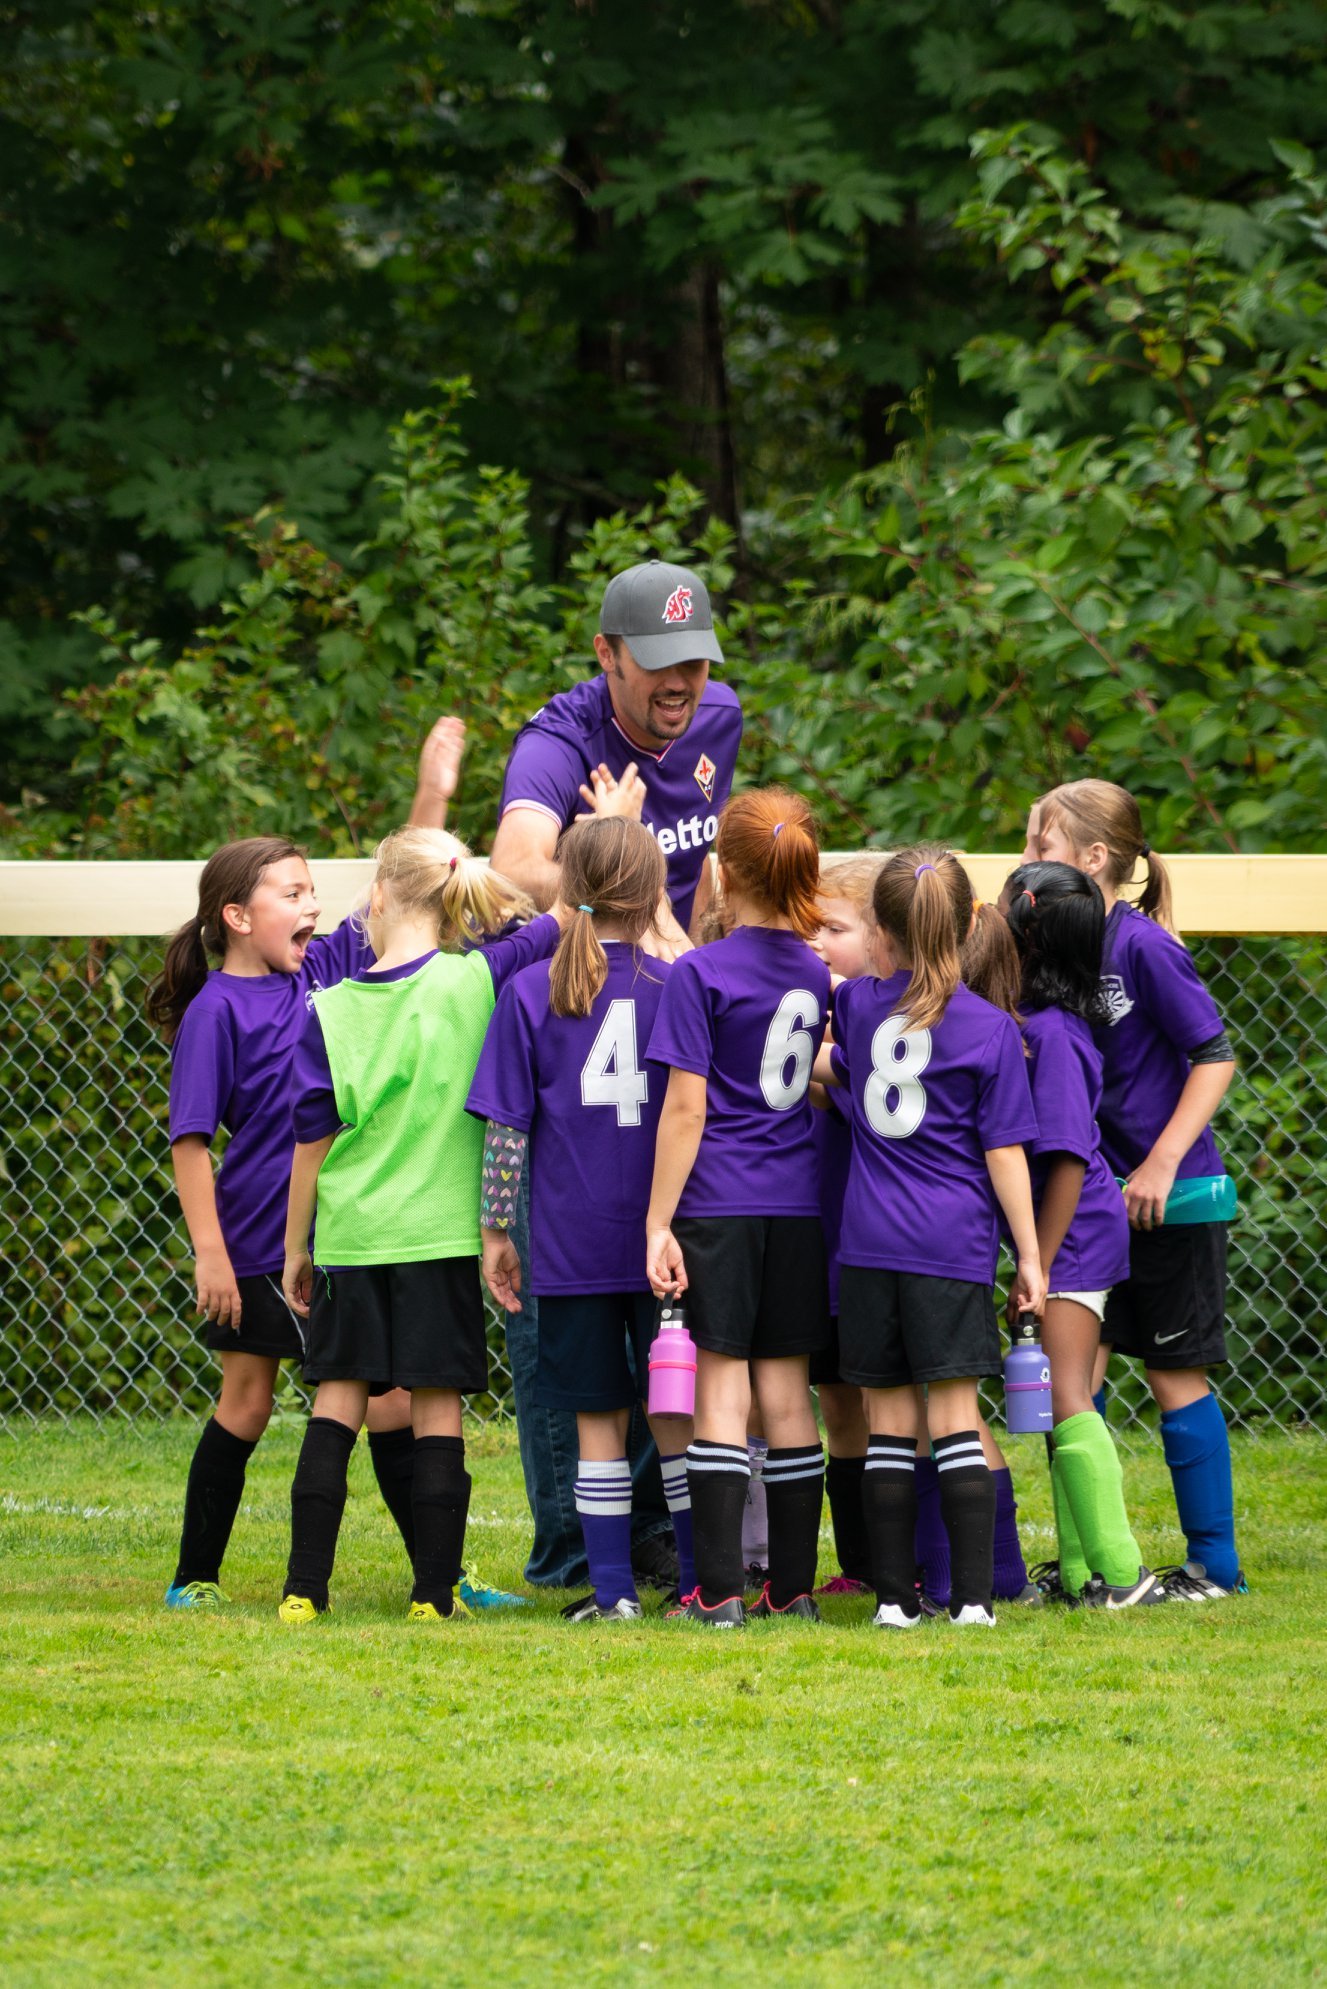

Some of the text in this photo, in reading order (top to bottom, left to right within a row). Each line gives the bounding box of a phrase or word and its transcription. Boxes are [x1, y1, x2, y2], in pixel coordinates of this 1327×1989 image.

[581, 999, 648, 1126] 4
[759, 988, 820, 1111] 6
[864, 1014, 932, 1139] 8
